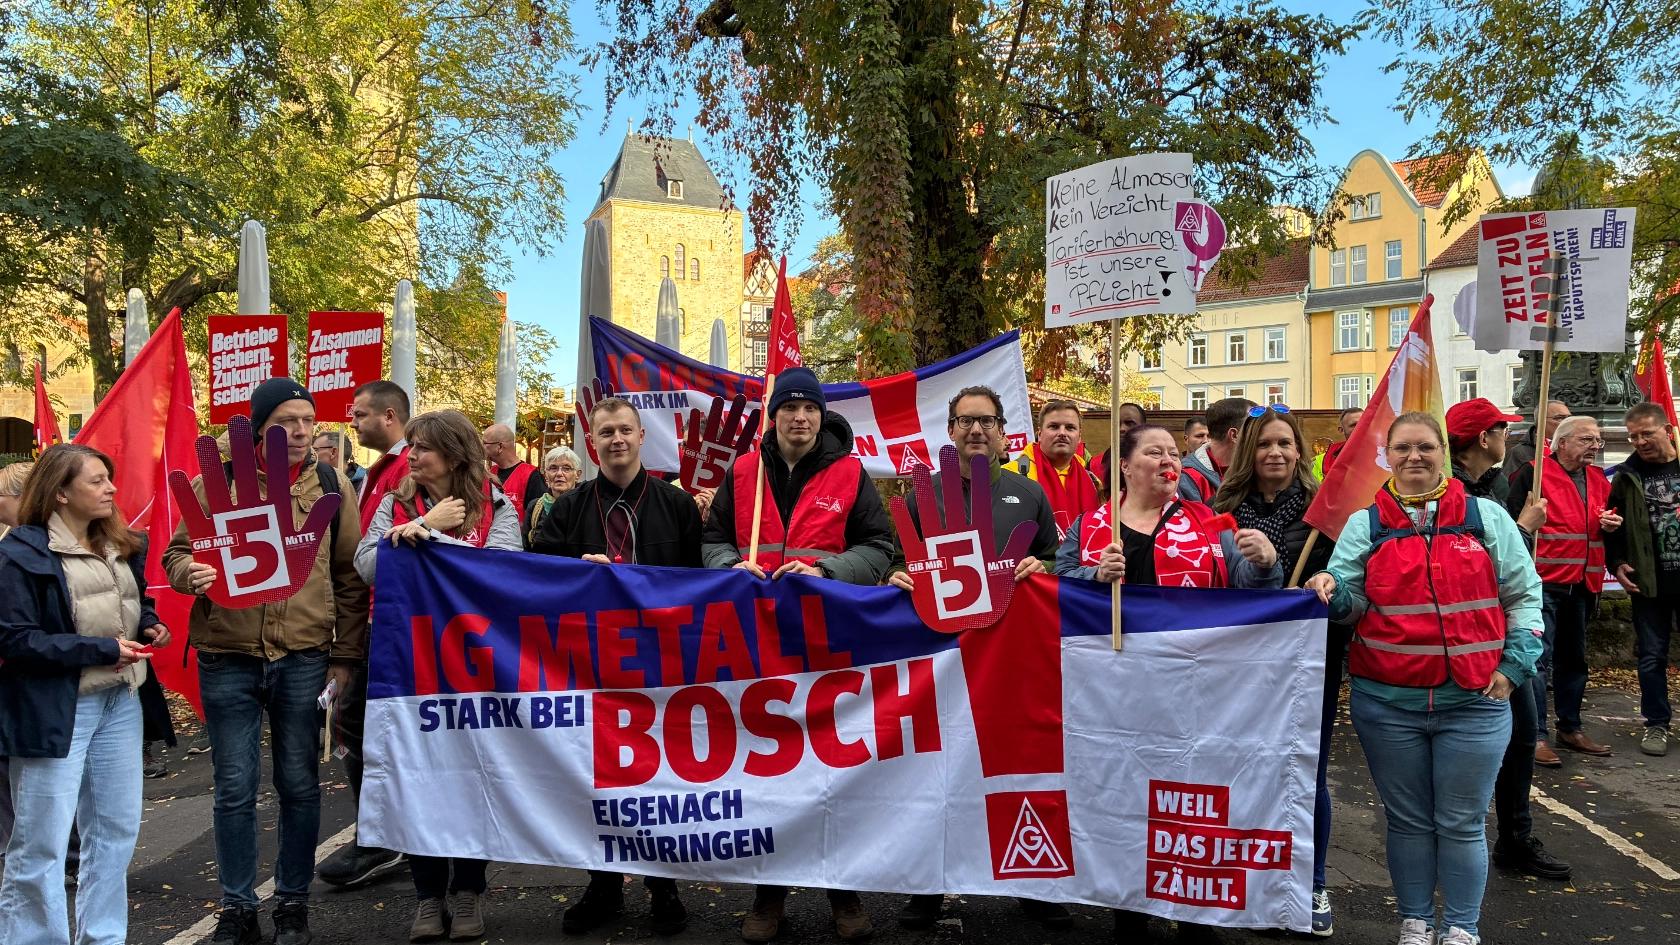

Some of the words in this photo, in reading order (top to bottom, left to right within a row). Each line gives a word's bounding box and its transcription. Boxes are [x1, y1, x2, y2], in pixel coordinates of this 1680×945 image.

[1050, 177, 1099, 209] Keine
[1090, 193, 1170, 221] Verzicht
[1605, 210, 1615, 231] JETZT
[1615, 222, 1625, 247] ZÄHLT.
[1496, 237, 1522, 268] ZU
[1592, 229, 1602, 247] WEIL
[1604, 232, 1613, 247] DAS
[1064, 260, 1090, 282] ist
[1100, 255, 1169, 274] unsere
[1500, 275, 1528, 323] ZEIT
[211, 326, 279, 354] Betriebe
[309, 327, 381, 353] Zusammen
[212, 346, 274, 371] sichern.
[309, 349, 349, 375] geht
[606, 353, 650, 393] IG
[212, 362, 273, 390] Zukunft
[308, 371, 356, 393] mehr.
[667, 392, 690, 409] IM
[192, 540, 212, 550] GIB
[213, 536, 235, 547] MIR
[225, 513, 279, 589] 5
[908, 562, 924, 573] GIB
[925, 559, 944, 570] MIR
[935, 539, 983, 613] 5
[411, 613, 495, 695] IG
[518, 594, 852, 691] METALL
[419, 697, 526, 733] STARK
[530, 694, 585, 730] BEI
[592, 656, 942, 789] BOSCH
[593, 788, 743, 828] EISENACH
[1155, 789, 1220, 819] WEIL
[598, 825, 775, 865] THÜRINGEN
[1154, 830, 1205, 859] DAS
[1211, 836, 1287, 867] JETZT
[1153, 866, 1239, 904] ZÄHLT.
